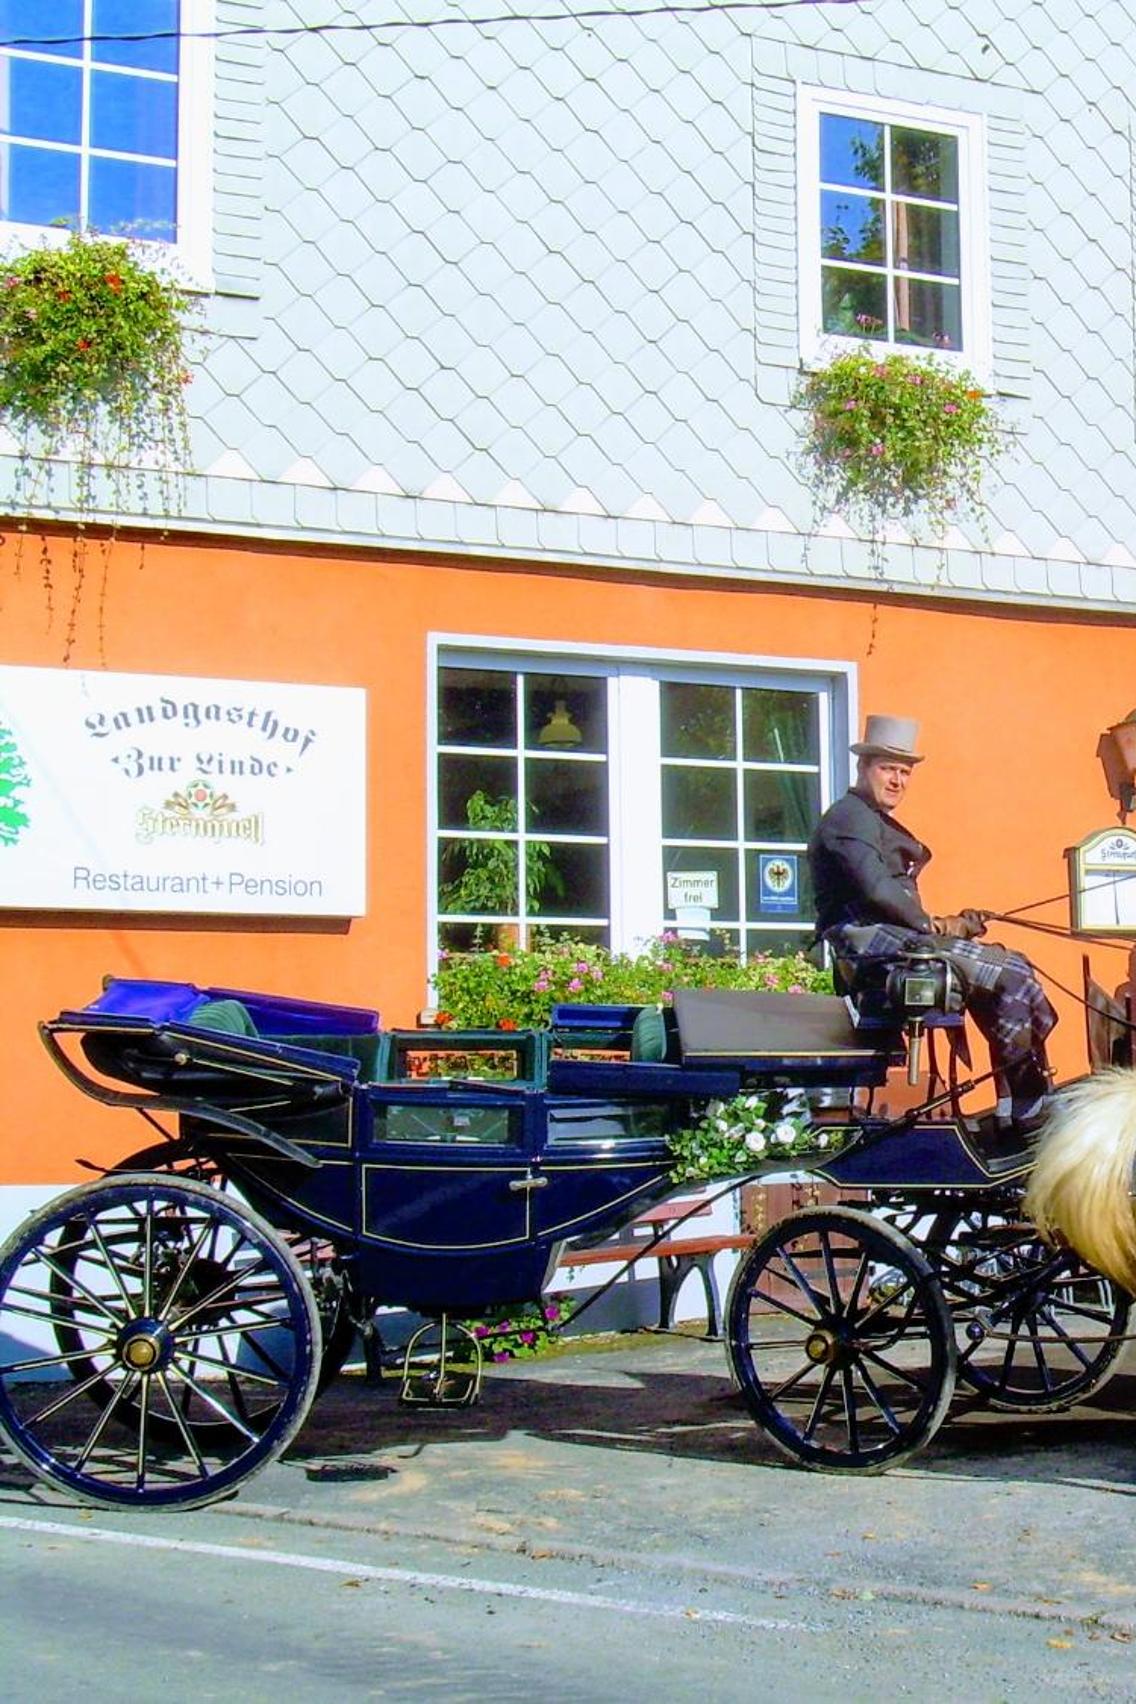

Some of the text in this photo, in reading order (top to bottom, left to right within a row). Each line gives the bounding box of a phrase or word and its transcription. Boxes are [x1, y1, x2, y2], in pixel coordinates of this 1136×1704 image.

[85, 697, 316, 757] Landgasthof
[123, 747, 279, 779] Zur Linde
[135, 806, 264, 845] Sternquell
[671, 877, 714, 889] Zimmer
[684, 891, 703, 904] frei
